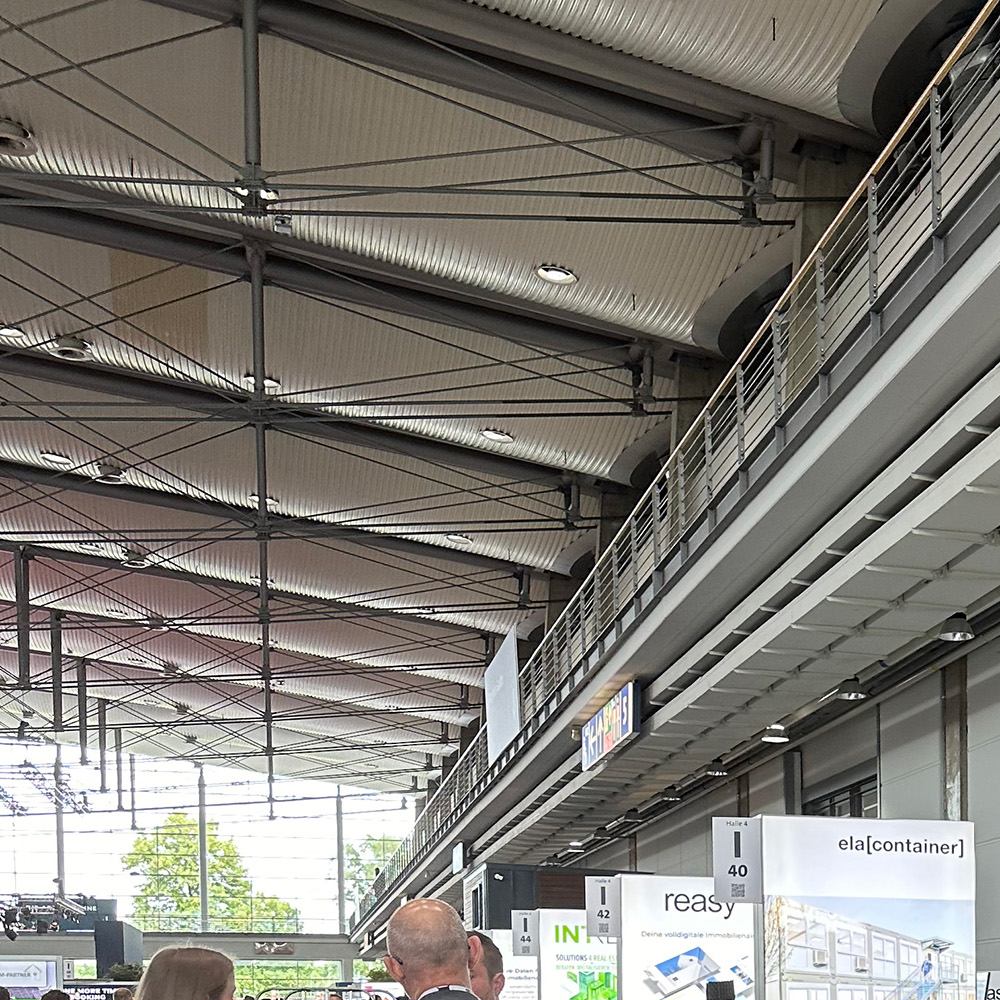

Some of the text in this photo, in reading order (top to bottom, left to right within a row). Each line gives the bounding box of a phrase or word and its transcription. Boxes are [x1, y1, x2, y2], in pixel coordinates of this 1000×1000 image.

[838, 835, 964, 858] ela[container]
[728, 864, 748, 878] 40
[597, 909, 610, 919] 42
[520, 935, 532, 943] 44
[664, 931, 704, 939] volldigitale
